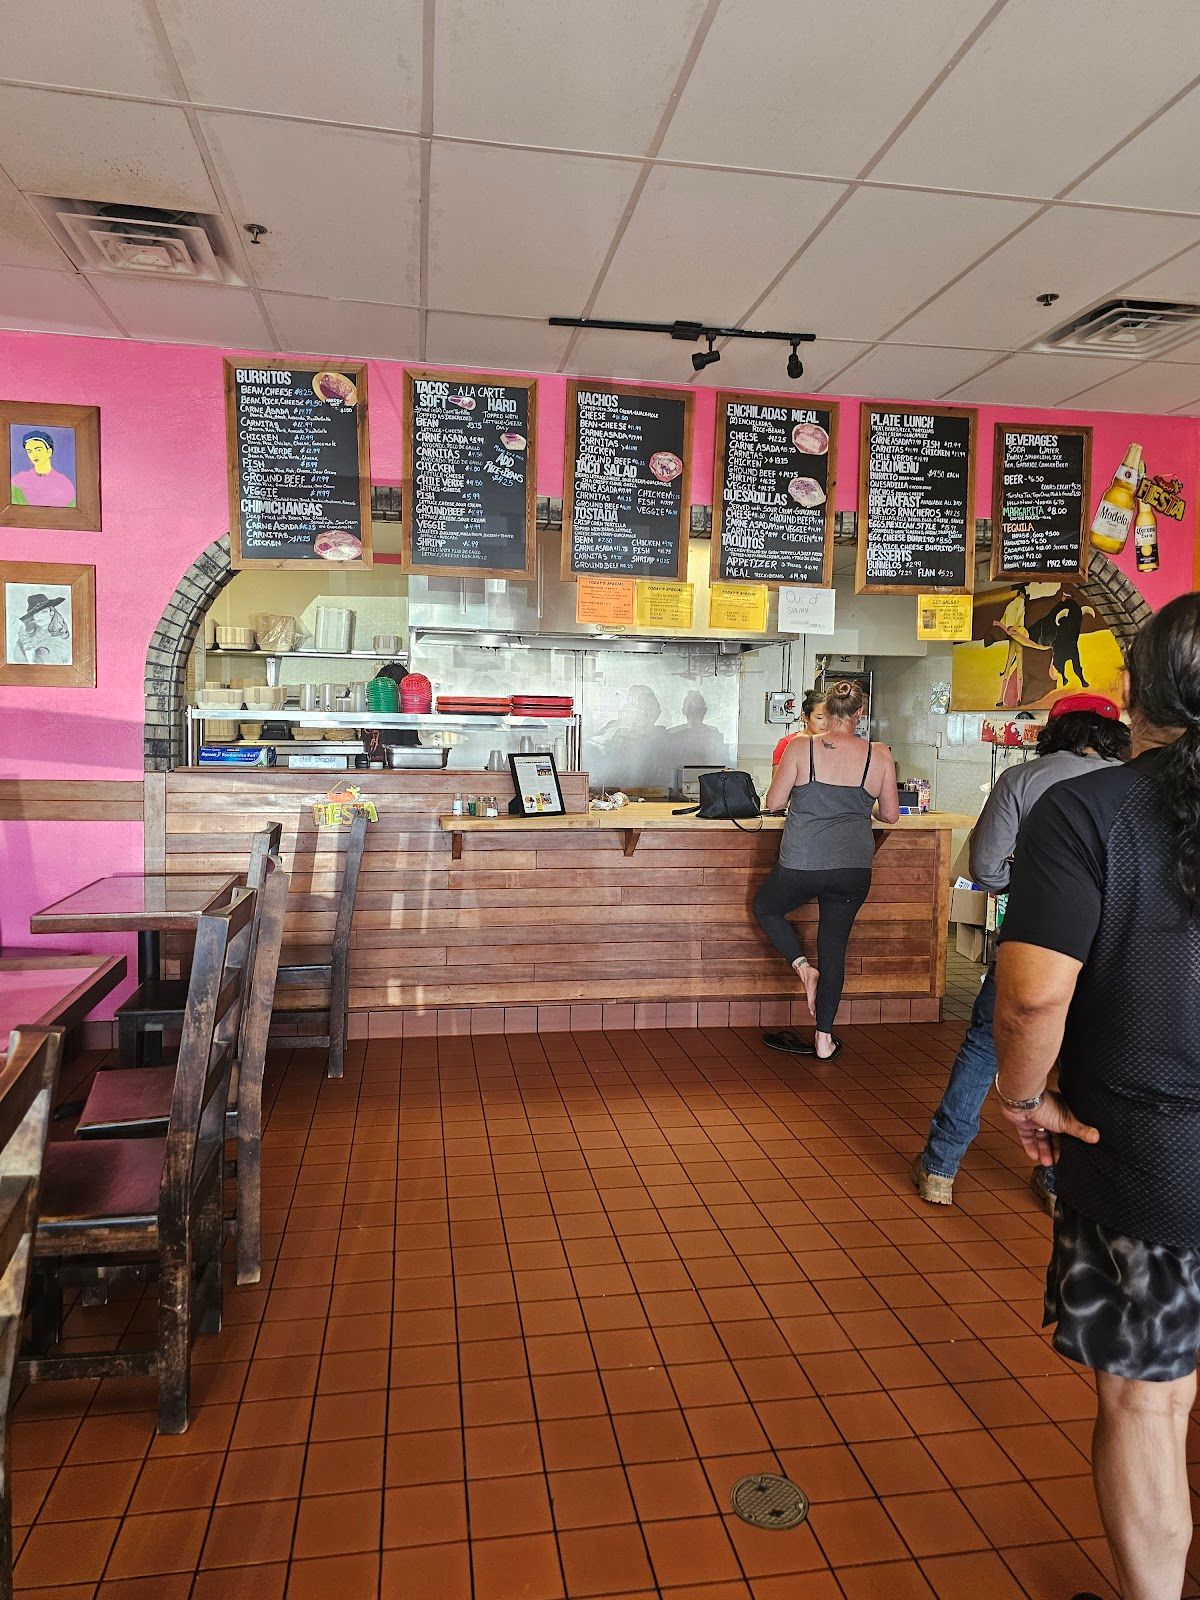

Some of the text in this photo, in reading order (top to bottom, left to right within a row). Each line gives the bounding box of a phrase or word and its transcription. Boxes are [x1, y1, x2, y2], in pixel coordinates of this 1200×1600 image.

[236, 369, 292, 385] BURRITOS
[415, 381, 450, 395] TACOS
[478, 388, 506, 398] CARTE
[420, 395, 448, 408] SOFT
[578, 391, 619, 407] NACHOS
[487, 398, 517, 412] HARD
[579, 410, 606, 421] CHEESE
[727, 404, 819, 423] ENCHILADAS MEAL
[241, 417, 280, 428] CARNITAS
[416, 417, 439, 428] BEAN
[730, 417, 738, 425] (2)
[871, 413, 934, 428] PLATE LUNCH
[240, 430, 278, 441] CHICKEN
[416, 432, 441, 442] CARNE
[443, 434, 469, 444] ASADA
[580, 428, 628, 440] CARNE ASADA
[730, 431, 758, 442] CHEESE
[580, 436, 619, 447] CARNITAS
[871, 436, 940, 448] CARNE ASADA FISH
[1006, 433, 1058, 447] BEVERAGES
[242, 444, 292, 454] CHILE VERDE
[579, 445, 616, 456] CHICKEN
[729, 440, 780, 453] CARNE ASADA
[871, 444, 950, 457] CARNITAS CHICKEN
[1008, 445, 1025, 453] SODA
[416, 446, 460, 459] CARNITAS
[729, 449, 763, 460] CARNITAS
[892, 454, 913, 462] VERDE
[243, 459, 265, 468] FISH
[496, 452, 514, 468] ADD
[579, 453, 631, 465] GROUND BEEF
[728, 457, 762, 468] CHICKEN
[415, 461, 455, 473] CHICKEN
[576, 460, 601, 474] TACO
[603, 464, 637, 478] SALAD
[728, 465, 776, 478] GROUND BEEF
[870, 460, 919, 474] KEIKI MENU
[243, 472, 305, 483] GROUND BEEF
[416, 474, 441, 486] CHILE
[443, 476, 464, 488] VERDE
[728, 473, 757, 484] SHRIMP
[870, 472, 898, 480] BURRITO
[1004, 474, 1023, 485] BEER
[575, 481, 618, 494] CARNE ASADA
[726, 480, 756, 490] VEGGIE
[870, 480, 908, 489] QUESADILLA
[243, 486, 278, 497] VEGGIE
[416, 490, 435, 500] FISH
[575, 491, 610, 501] CARNITAS
[637, 489, 672, 499] CHICKEN
[870, 488, 894, 496] NACHOS
[638, 498, 656, 506] FISH
[724, 489, 787, 506] QUESADILLAS
[869, 495, 921, 508] BREAKFAST
[1138, 478, 1185, 521] FIESTA
[241, 499, 323, 516] CHIMICHANGAS
[575, 500, 604, 508] GROUND
[762, 505, 777, 513] SOUR
[416, 504, 466, 516] GROUND BEEF
[574, 507, 618, 522] TOSTADA
[636, 507, 665, 516] VEGGIE
[869, 508, 941, 518] HUEVOS RANCHEROS
[1003, 506, 1067, 517] MARGARITA $8.00
[726, 509, 812, 525] CHEESE GROUND BEEF
[1100, 506, 1128, 526] Modelo
[246, 519, 298, 530] CARNE ASADA
[416, 519, 447, 530] VEGGIE
[726, 518, 807, 533] CARNE ASADA VEGGIE
[869, 519, 885, 528] EGGS
[886, 520, 915, 529] MEXICAN
[1002, 522, 1034, 532] TEQUILA
[246, 530, 289, 538] CARNITAS
[726, 526, 812, 543] CARNITAS CHICKEN
[907, 535, 935, 543] BURRITO
[247, 539, 281, 547] CHICKEN
[416, 537, 446, 547] SHRIMP
[574, 536, 593, 544] BEAN
[631, 539, 661, 547] CHICKEN
[722, 533, 764, 549] TAQUITOS
[631, 555, 655, 564] SHRIMP
[867, 548, 912, 561] DESSERTS
[574, 561, 605, 569] GROUND
[726, 557, 777, 570] APPETIZER
[726, 567, 750, 578] MEAL
[867, 568, 936, 577] CHURRO FLAN
